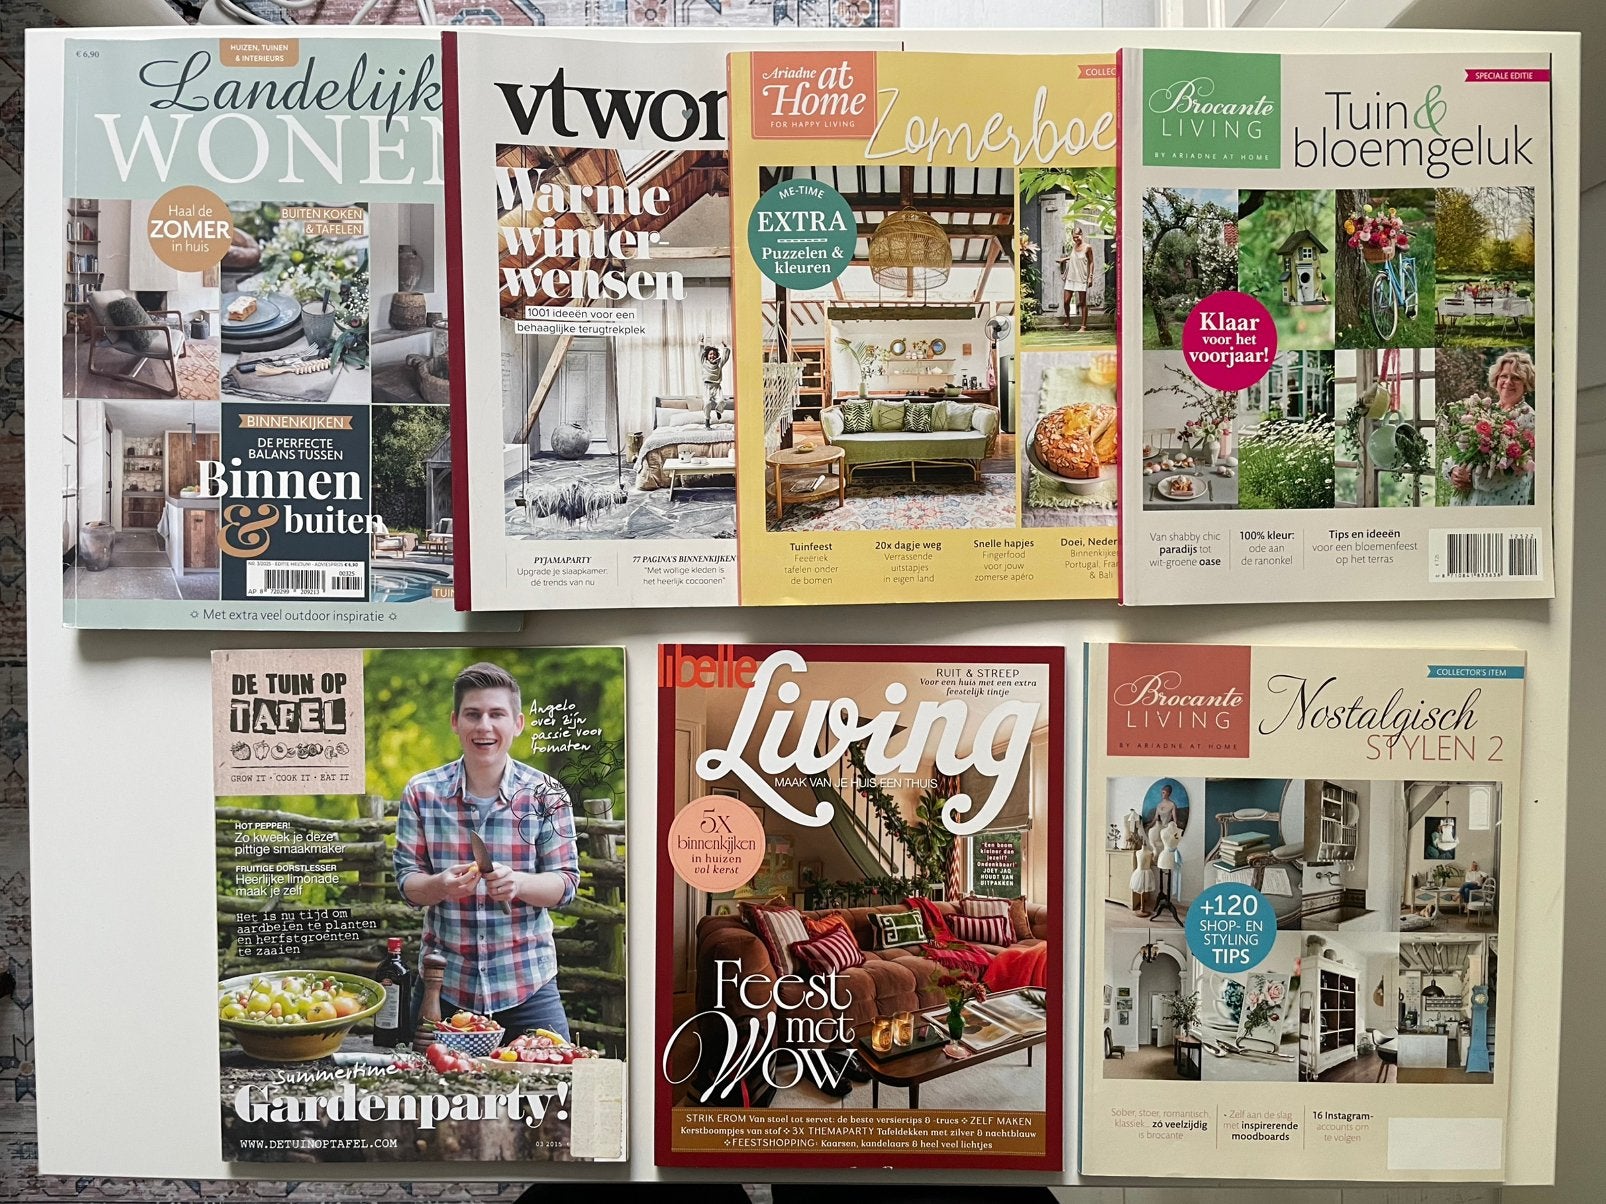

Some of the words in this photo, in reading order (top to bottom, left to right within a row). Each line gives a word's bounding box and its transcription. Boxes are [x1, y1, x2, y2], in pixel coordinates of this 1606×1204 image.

[75, 50, 82, 58] €
[83, 50, 100, 59] 6,90
[230, 44, 260, 53] HUIZEN,
[261, 44, 289, 52] TUINEN
[235, 54, 241, 62] &
[242, 54, 285, 63] INTERIEURS
[762, 65, 817, 80] Ariadne
[818, 60, 854, 90] at
[1475, 71, 1508, 80] SPECIALE
[1510, 71, 1533, 80] EDITIE
[139, 50, 443, 133] Landelijk
[1149, 76, 1274, 116] Brocante
[762, 83, 867, 116] Home
[1325, 91, 1408, 130] Tuin
[1413, 84, 1448, 136] &
[791, 120, 820, 128] HAPPY
[824, 120, 855, 128] LIVING
[1161, 119, 1263, 139] LIVING
[1295, 125, 1534, 179] bloemgeluk
[493, 166, 671, 216] Warme
[778, 185, 825, 200] ME-TIME
[168, 205, 196, 218] Haal
[198, 205, 213, 218] de
[282, 208, 321, 220] BUITEN
[323, 208, 363, 220] KOKEN
[305, 224, 314, 235] &
[315, 223, 363, 235] TAFELEN
[757, 210, 848, 233] EXTRA
[150, 220, 231, 240] ZOMER
[499, 217, 670, 260] winter-
[171, 240, 182, 252] in
[184, 240, 210, 253] huis
[761, 246, 827, 261] Puzzelen
[831, 246, 844, 260] &
[774, 260, 832, 274] kleuren
[499, 267, 687, 300] wensen
[527, 308, 550, 318] 1001
[552, 309, 588, 319] ideeën
[590, 311, 613, 319] voor
[615, 311, 635, 319] een
[1199, 311, 1260, 331] Klaar
[517, 323, 576, 335] behaaglijke
[578, 324, 646, 336] terugtrekplek
[1202, 336, 1232, 346] voor
[1236, 332, 1257, 346] het
[1189, 346, 1269, 369] voorjaar!
[247, 415, 344, 431] BINNENKIJKEN
[257, 438, 275, 449] DE
[276, 438, 334, 450] PERFECTE
[248, 448, 296, 460] BALANS
[297, 449, 343, 461] TUSSEN
[196, 457, 363, 500] Binnen
[217, 503, 280, 558] &
[284, 505, 383, 535] buiten
[1149, 532, 1167, 541] Van
[1168, 531, 1200, 545] shabby
[1202, 531, 1221, 542] chic
[1240, 531, 1265, 541] 100%
[1267, 530, 1295, 541] kleur:
[1329, 529, 1349, 540] Tips
[1351, 531, 1364, 539] en
[1366, 529, 1401, 539] ideeën
[789, 542, 833, 552] Tuinfeest
[875, 541, 892, 550] 20x
[894, 540, 920, 552] dagje
[921, 541, 942, 552] weg
[973, 538, 1002, 549] Snelle
[1004, 538, 1035, 551] hapjes
[533, 556, 592, 566] PYJAMAPARTY
[642, 555, 678, 564] PAGINA'S
[678, 555, 736, 564] BINNENKIJKEN
[203, 609, 227, 621] Met
[229, 610, 258, 621] extra
[260, 609, 283, 621] veel
[285, 609, 330, 622] outdoor
[332, 609, 384, 624] inspiratie
[657, 644, 757, 689] libelle
[936, 668, 962, 678] RUIT
[965, 668, 973, 678] &
[977, 668, 1020, 678] STREEP
[1436, 668, 1487, 677] COLLECTOR'S
[1488, 668, 1507, 677] ITEM
[232, 673, 258, 695] DE
[266, 673, 315, 695] TUIN
[321, 672, 347, 695] OP
[1114, 670, 1245, 707] Brocante
[230, 697, 347, 735] TAFEL
[529, 699, 576, 718] Angelo
[1258, 674, 1483, 748] Nostalgisch
[530, 717, 556, 727] over
[562, 712, 587, 730] zijn
[1127, 711, 1231, 730] LIVING
[531, 727, 572, 748] passie
[576, 727, 602, 737] voor
[695, 649, 1041, 836] Living
[532, 740, 592, 754] tomaten
[1367, 734, 1475, 761] STYLEN
[1487, 735, 1504, 762] 2
[774, 777, 807, 788] MAAK
[808, 777, 832, 788] VAN
[834, 777, 849, 789] JE
[850, 777, 877, 789] HUIS
[878, 777, 902, 789] EEN
[904, 778, 938, 790] THUIS
[235, 822, 252, 830] HOT
[253, 822, 291, 830] PEPPER!
[235, 832, 251, 844] Zo
[253, 832, 290, 844] kweek
[292, 832, 304, 845] je
[305, 831, 334, 843] deze
[677, 833, 757, 853] binnenkijken
[235, 844, 270, 858] pittige
[273, 843, 346, 856] smaakmaker
[691, 854, 701, 864] in
[704, 854, 742, 865] huizen
[235, 865, 274, 873] FRUITIGE
[276, 864, 337, 873] DORSTLESSER
[694, 864, 710, 875] vol
[712, 864, 739, 875] kerst
[235, 874, 284, 888] Heerlijke
[287, 873, 339, 885] limonade
[235, 886, 267, 896] maak
[269, 886, 282, 898] je
[283, 885, 303, 896] zelf
[1200, 895, 1258, 916] +120
[1199, 920, 1241, 932] SHOP-
[1246, 920, 1263, 932] EN
[236, 936, 252, 945] en
[255, 931, 360, 947] herfstgroenten
[1203, 933, 1259, 946] STYLING
[1211, 948, 1250, 964] TIPS
[713, 957, 852, 1011] Feest
[785, 1012, 856, 1044] met
[272, 1061, 401, 1086] Summertime
[234, 1081, 569, 1130] Gardenparty!
[1313, 1111, 1322, 1121] 16
[1325, 1111, 1374, 1123] Instagram-
[1152, 1120, 1163, 1129] zó
[1165, 1120, 1208, 1131] veelzijdig
[1241, 1121, 1299, 1132] inspirerende
[240, 1138, 398, 1150] WWW.DETUINOPTAFEL.COM
[1231, 1131, 1290, 1142] moodboards
